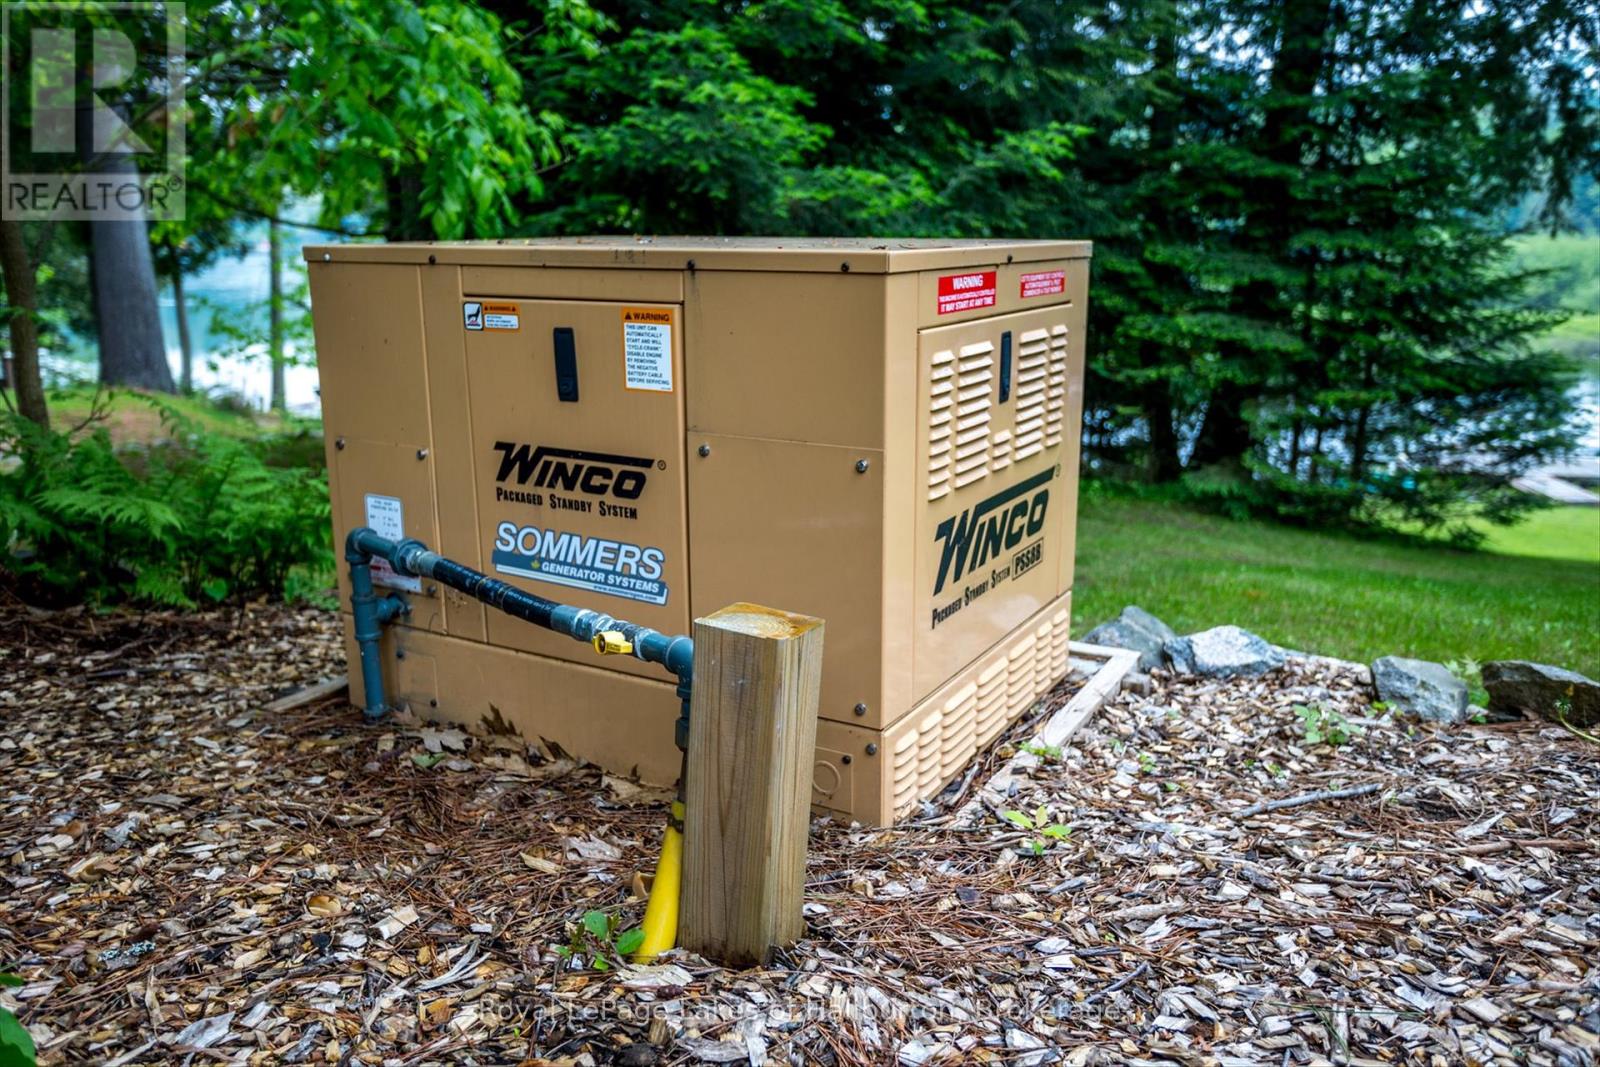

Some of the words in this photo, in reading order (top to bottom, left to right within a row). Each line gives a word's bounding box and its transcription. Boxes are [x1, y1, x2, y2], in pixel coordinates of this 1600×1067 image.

[953, 274, 984, 290] WARNING
[633, 313, 670, 321] WARNING
[495, 522, 664, 580] SOMMERS
[542, 561, 605, 582] GENERATOR
[608, 574, 660, 593] SYSTEMS
